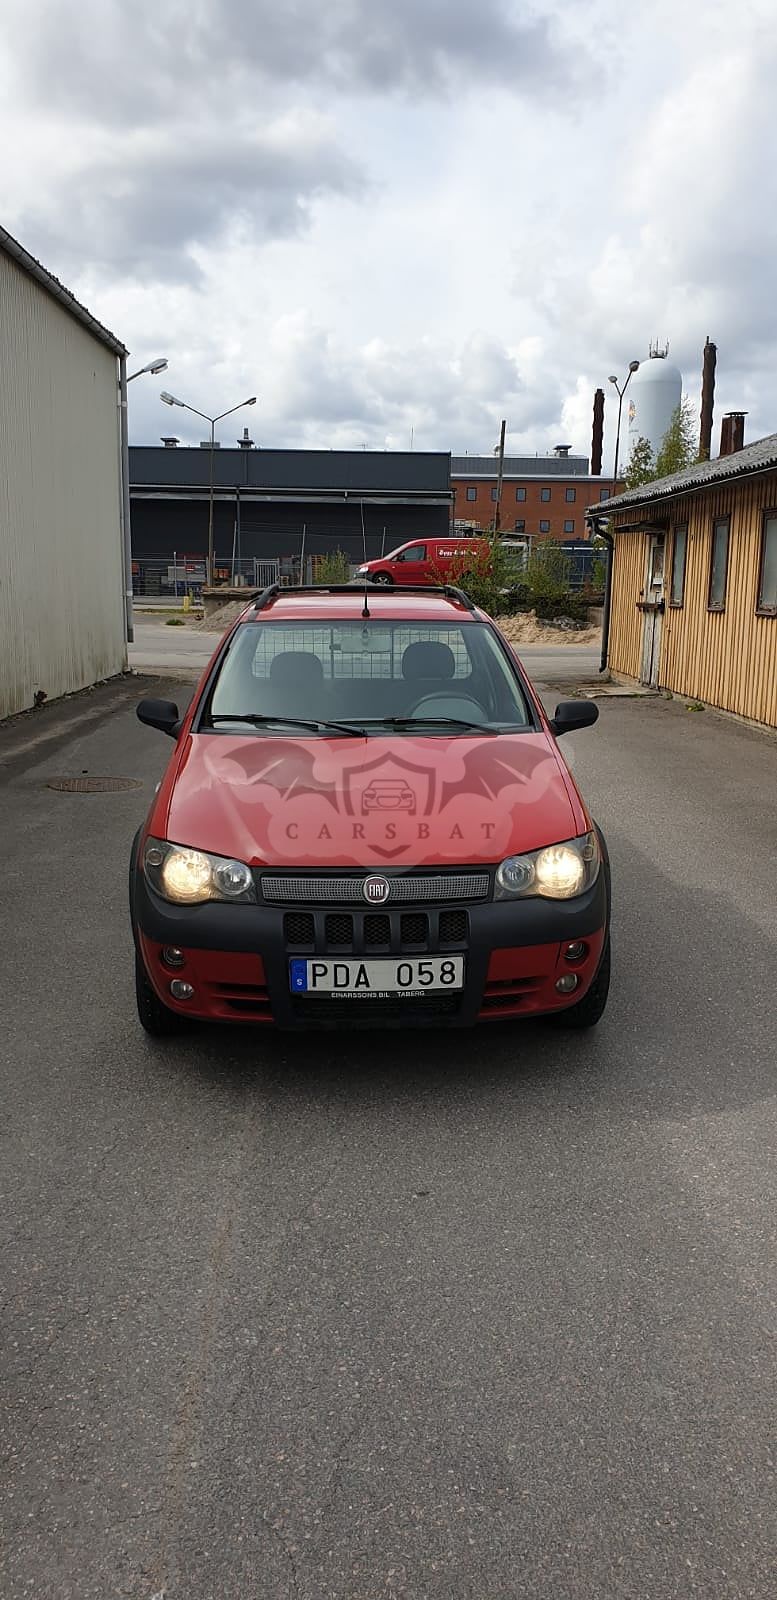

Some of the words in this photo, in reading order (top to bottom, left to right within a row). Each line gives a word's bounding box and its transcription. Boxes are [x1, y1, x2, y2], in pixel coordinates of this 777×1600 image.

[369, 884, 384, 897] FIAT
[312, 963, 370, 988] PDA
[396, 961, 456, 987] 058
[296, 978, 303, 986] S
